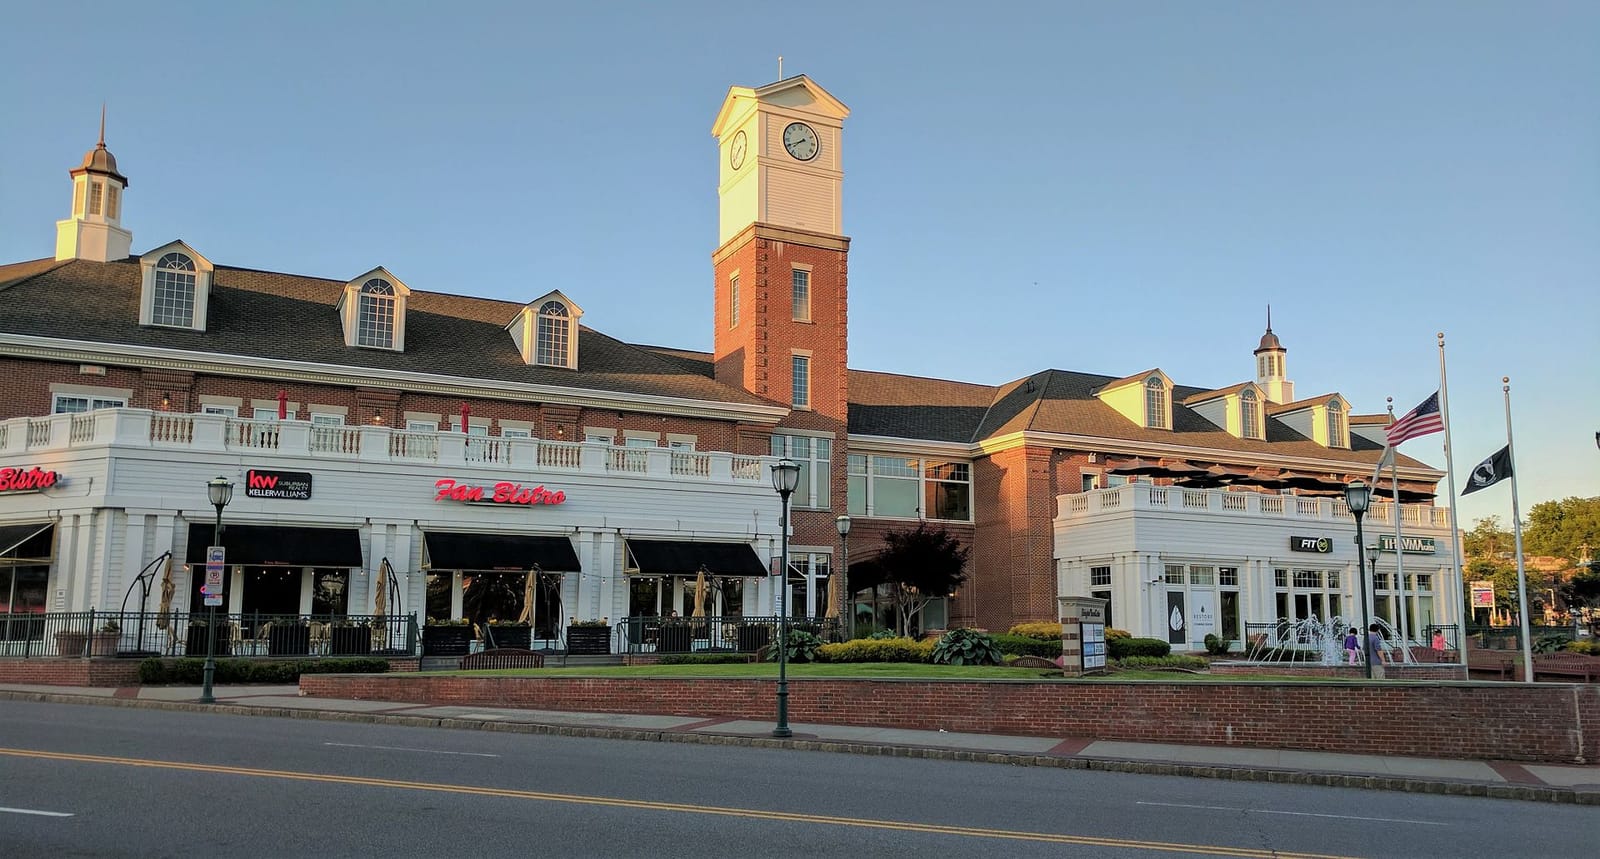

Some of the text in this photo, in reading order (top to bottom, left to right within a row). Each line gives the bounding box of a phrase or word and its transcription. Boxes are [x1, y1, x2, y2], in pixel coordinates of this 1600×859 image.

[0, 466, 57, 490] Bistro
[250, 470, 279, 489] kw
[435, 479, 566, 505] Fan Bistro
